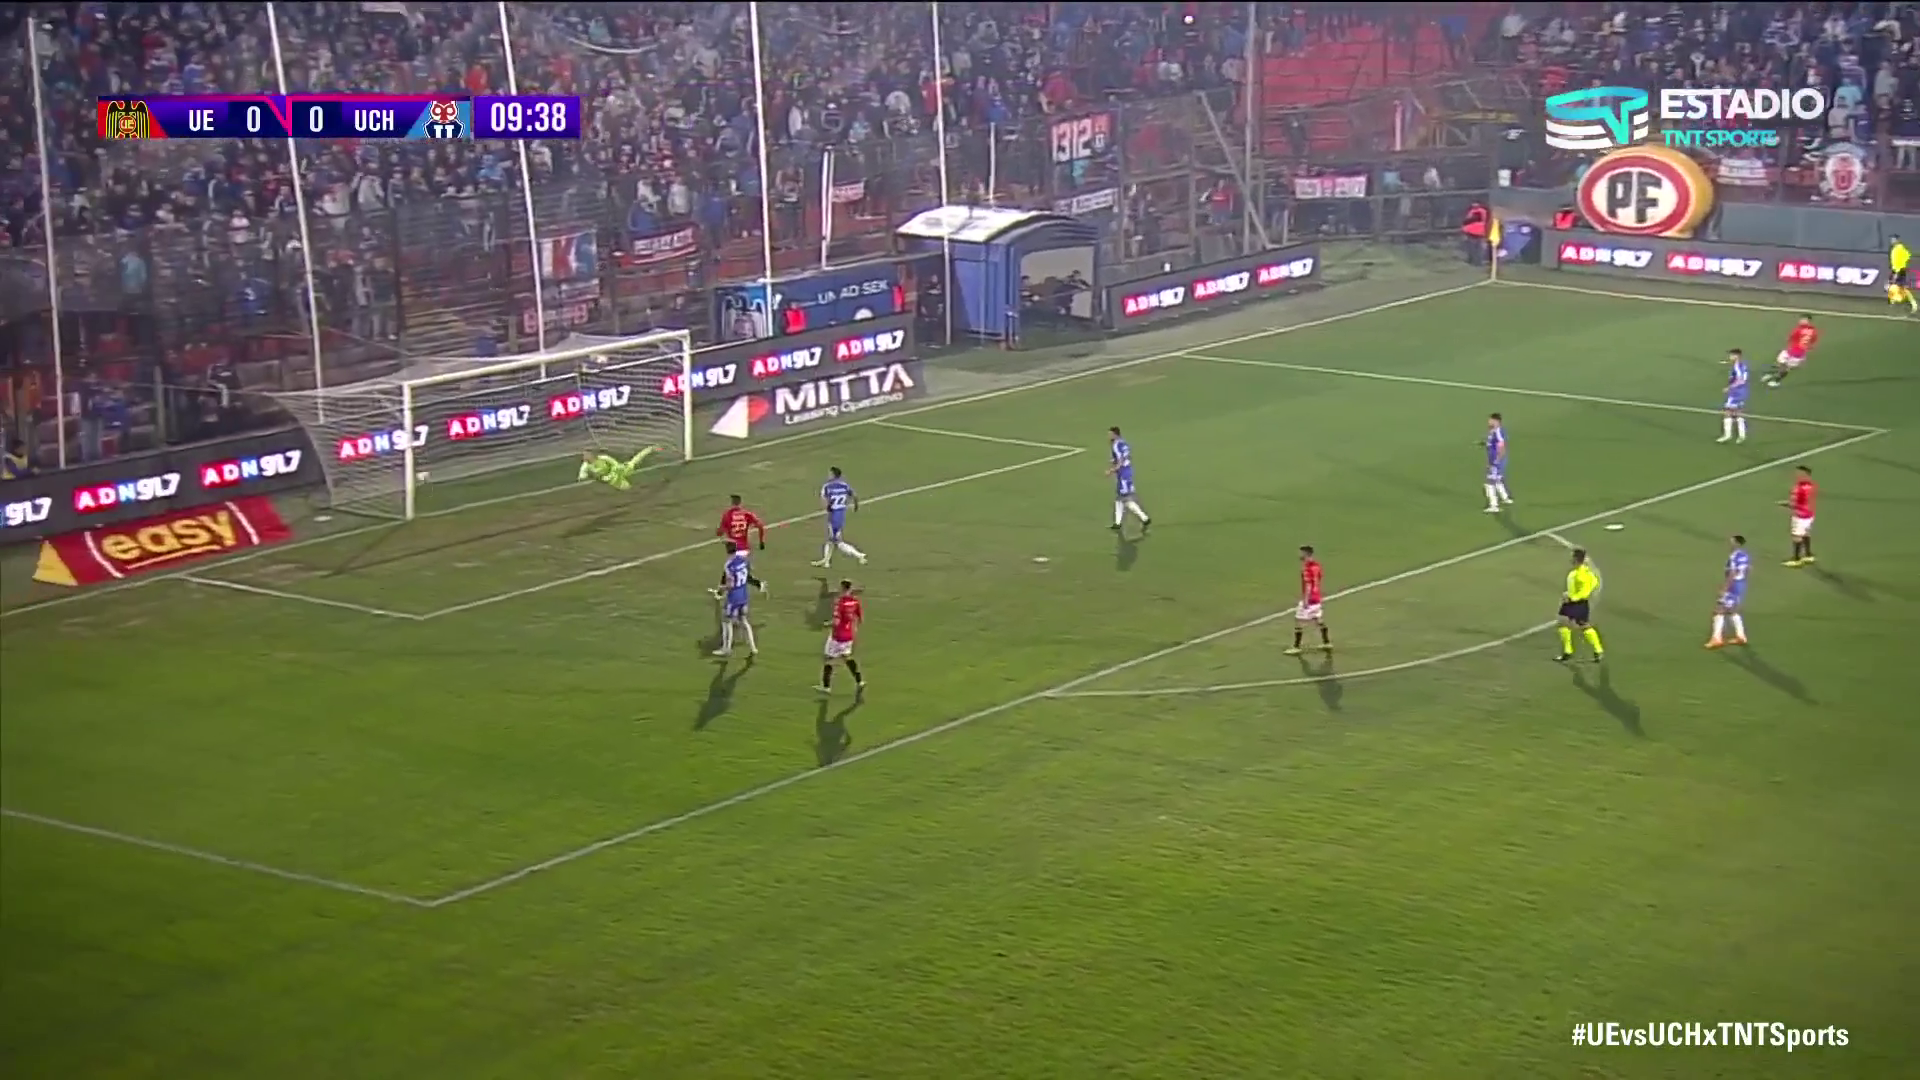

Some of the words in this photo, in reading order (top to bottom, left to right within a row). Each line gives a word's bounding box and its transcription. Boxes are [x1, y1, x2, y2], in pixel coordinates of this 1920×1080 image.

[1606, 169, 1663, 223] PF
[775, 363, 915, 415] MITTA
[784, 405, 839, 425] Leasing
[840, 392, 904, 413] Operativo
[830, 494, 847, 509] 22
[101, 510, 238, 561] easy
